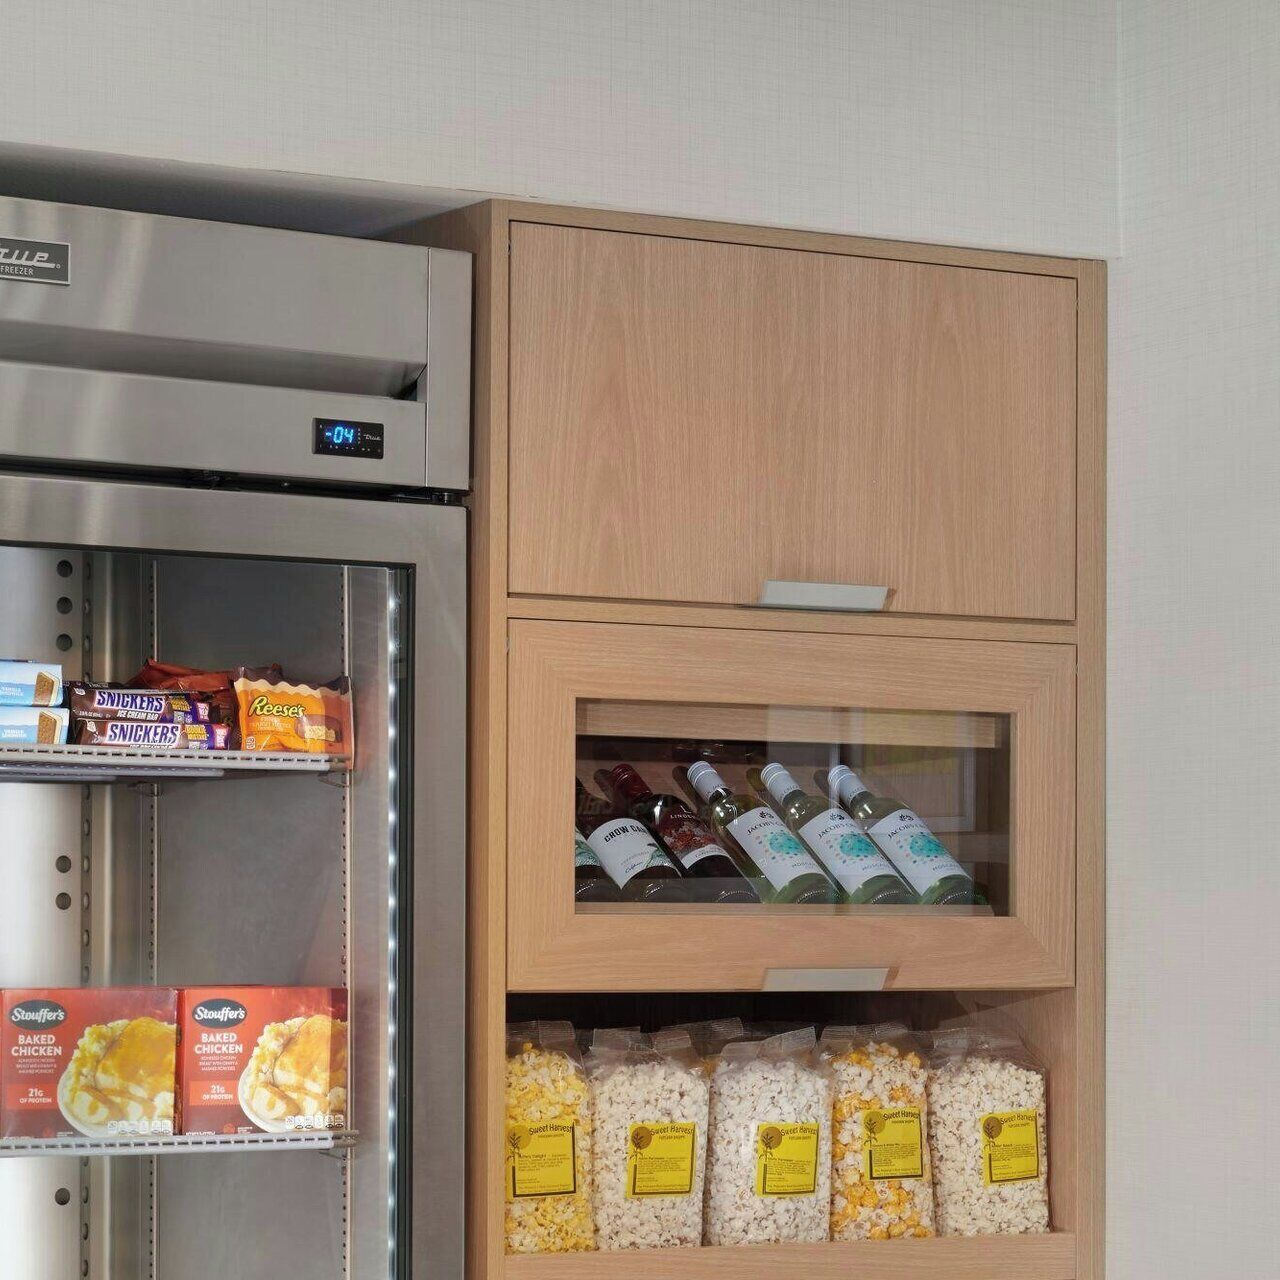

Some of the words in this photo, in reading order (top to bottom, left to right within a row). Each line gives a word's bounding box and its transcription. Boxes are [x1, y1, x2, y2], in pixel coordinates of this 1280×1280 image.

[0, 265, 34, 276] FREEZER
[96, 691, 165, 712] SNICKERS
[250, 696, 306, 718] Reese's
[126, 711, 147, 720] CREAM
[148, 713, 159, 721] BAR
[108, 723, 181, 744] SNICKERS
[11, 1006, 65, 1023] Stouffer's
[18, 1034, 56, 1045] BAKED
[201, 1033, 237, 1043] BAKED
[11, 1046, 62, 1057] CHICKEN
[194, 1044, 243, 1054] CHICKEN
[529, 1123, 549, 1134] Sweet
